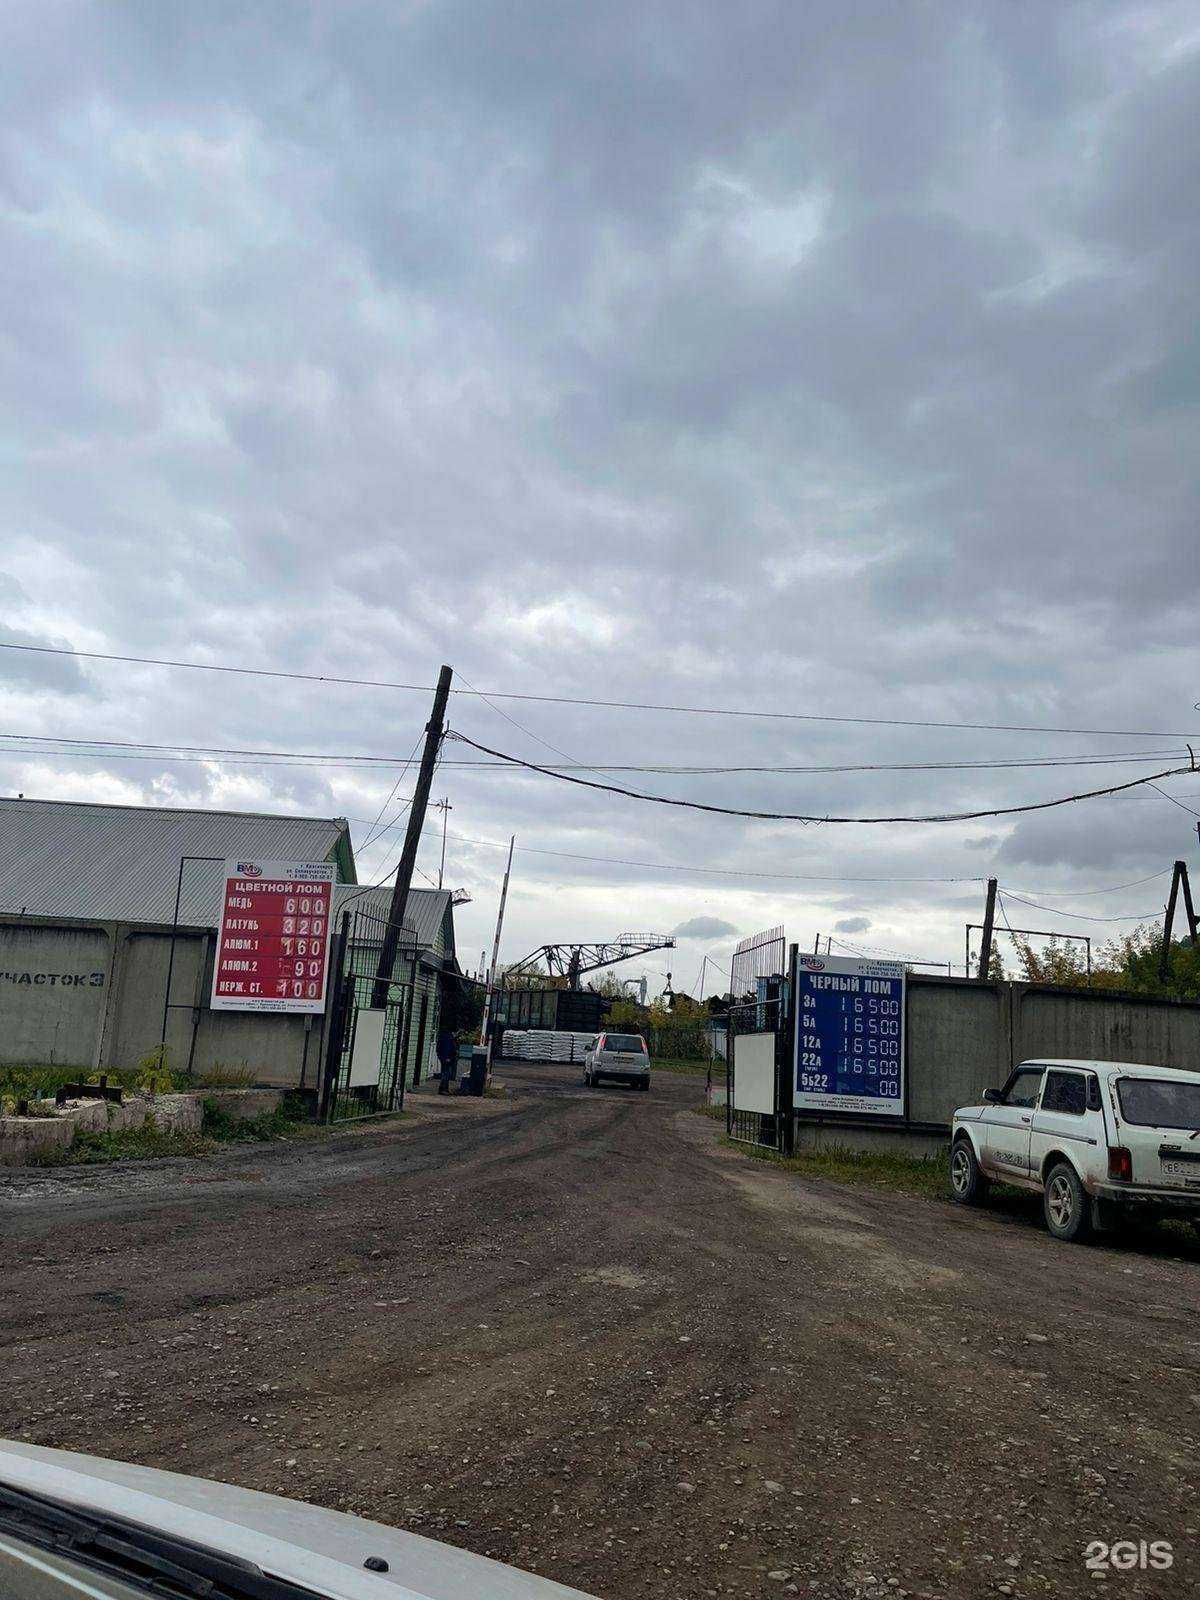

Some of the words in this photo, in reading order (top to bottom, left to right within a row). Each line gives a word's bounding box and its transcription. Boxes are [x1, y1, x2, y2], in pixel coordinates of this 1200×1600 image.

[235, 881, 293, 893] ЦВЕТНОЙ
[296, 884, 323, 893] ЛОМ
[228, 897, 252, 909] МЕДЬ
[286, 898, 324, 914] 600
[225, 919, 259, 930] ЛАТУНЬ
[283, 918, 322, 934] 320
[224, 939, 259, 950] АЛЮМ.1
[283, 939, 320, 955] 160
[221, 960, 258, 972] АЛЮМ.2
[249, 982, 264, 993] СТ.
[809, 975, 860, 992] ЧЕРНЫЙ
[864, 979, 891, 995] ЛОМ
[803, 1014, 816, 1028] 5А
[803, 1035, 821, 1049] 12А
[802, 1053, 822, 1067] 22А
